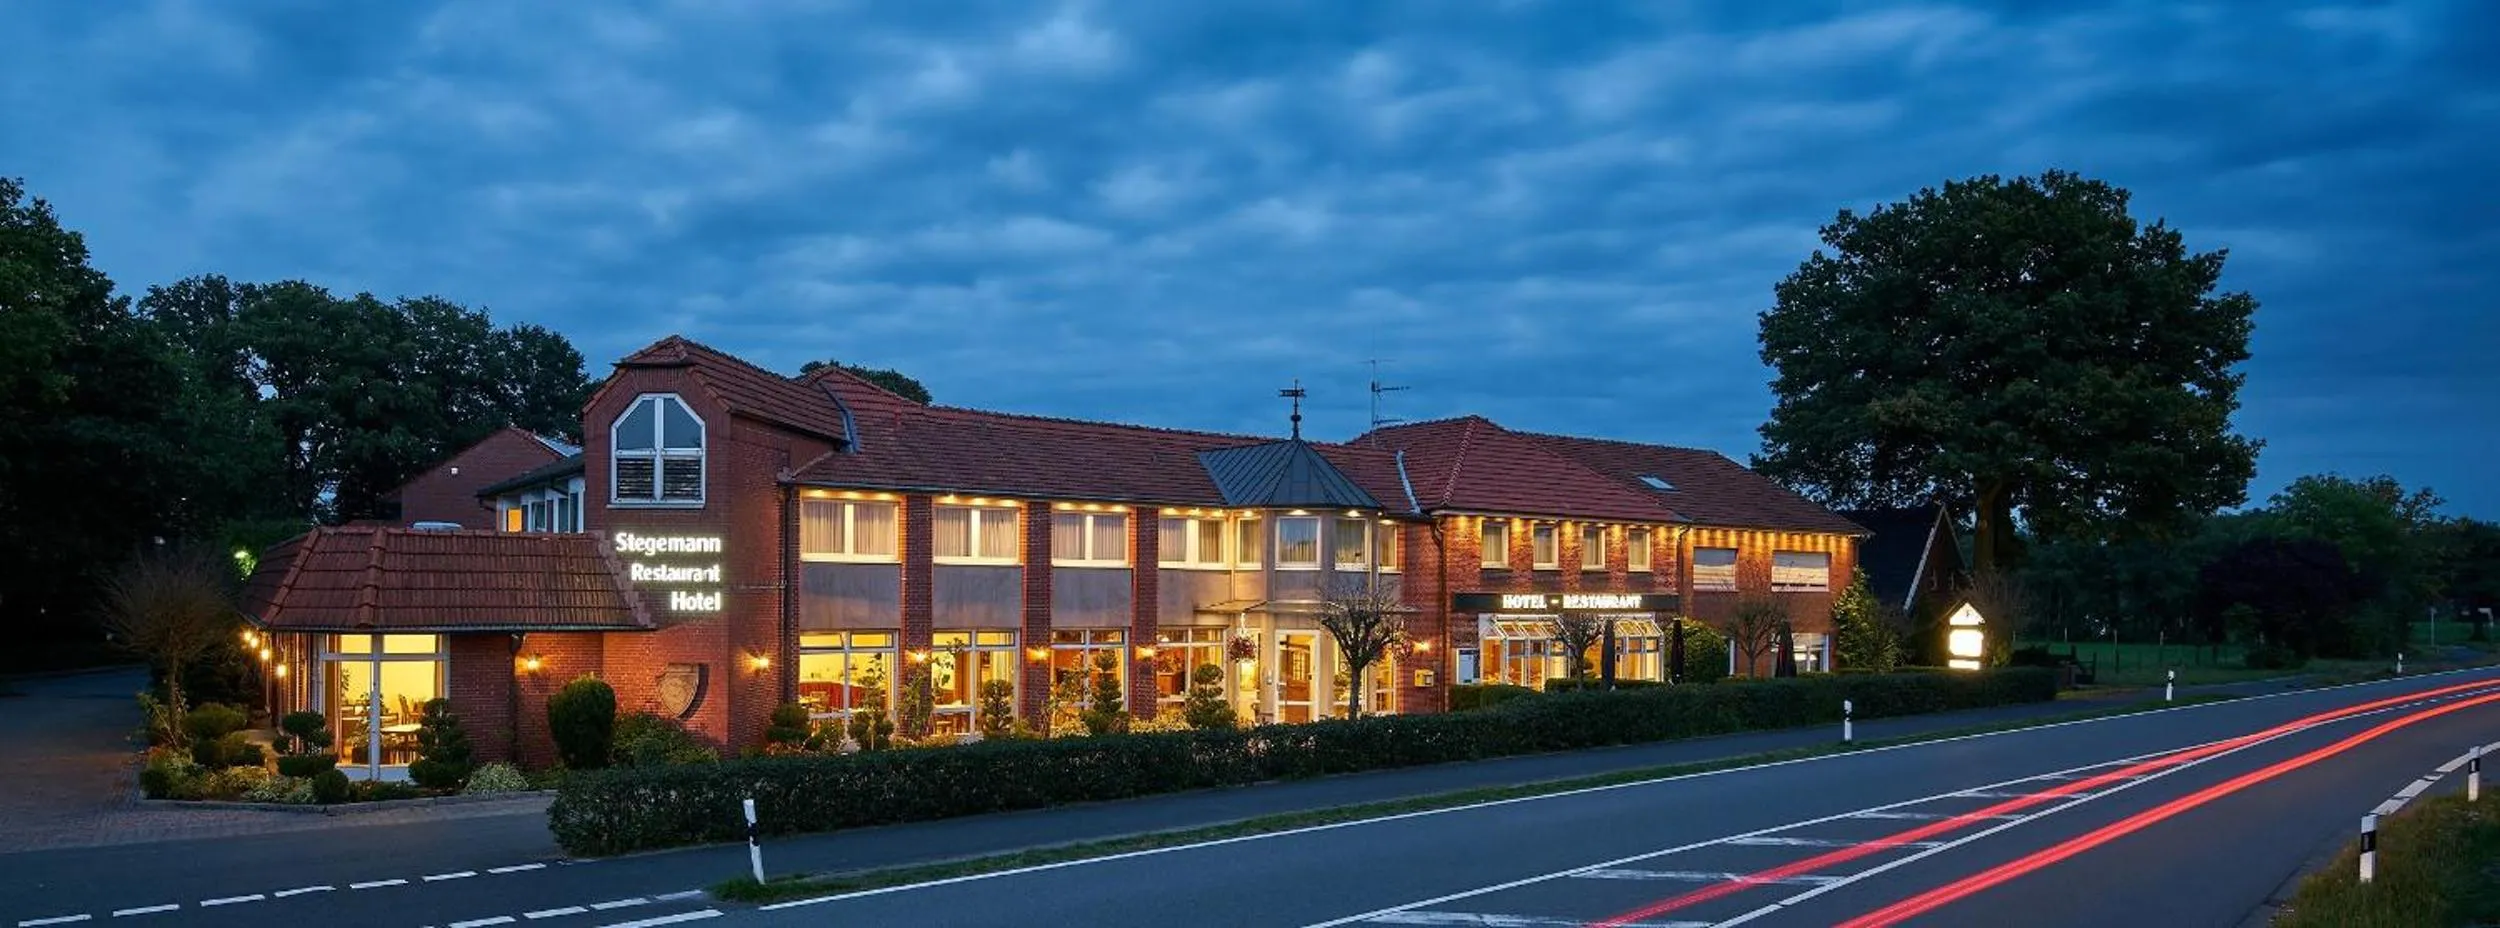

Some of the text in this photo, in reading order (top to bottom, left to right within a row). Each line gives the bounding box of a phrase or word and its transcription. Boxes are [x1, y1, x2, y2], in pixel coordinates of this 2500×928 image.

[615, 532, 721, 556] Stegemann
[631, 562, 721, 582] Restaurant
[671, 590, 721, 611] Hotel
[1502, 594, 1547, 609] HOTEL
[1562, 594, 1642, 609] RESTAURANT
